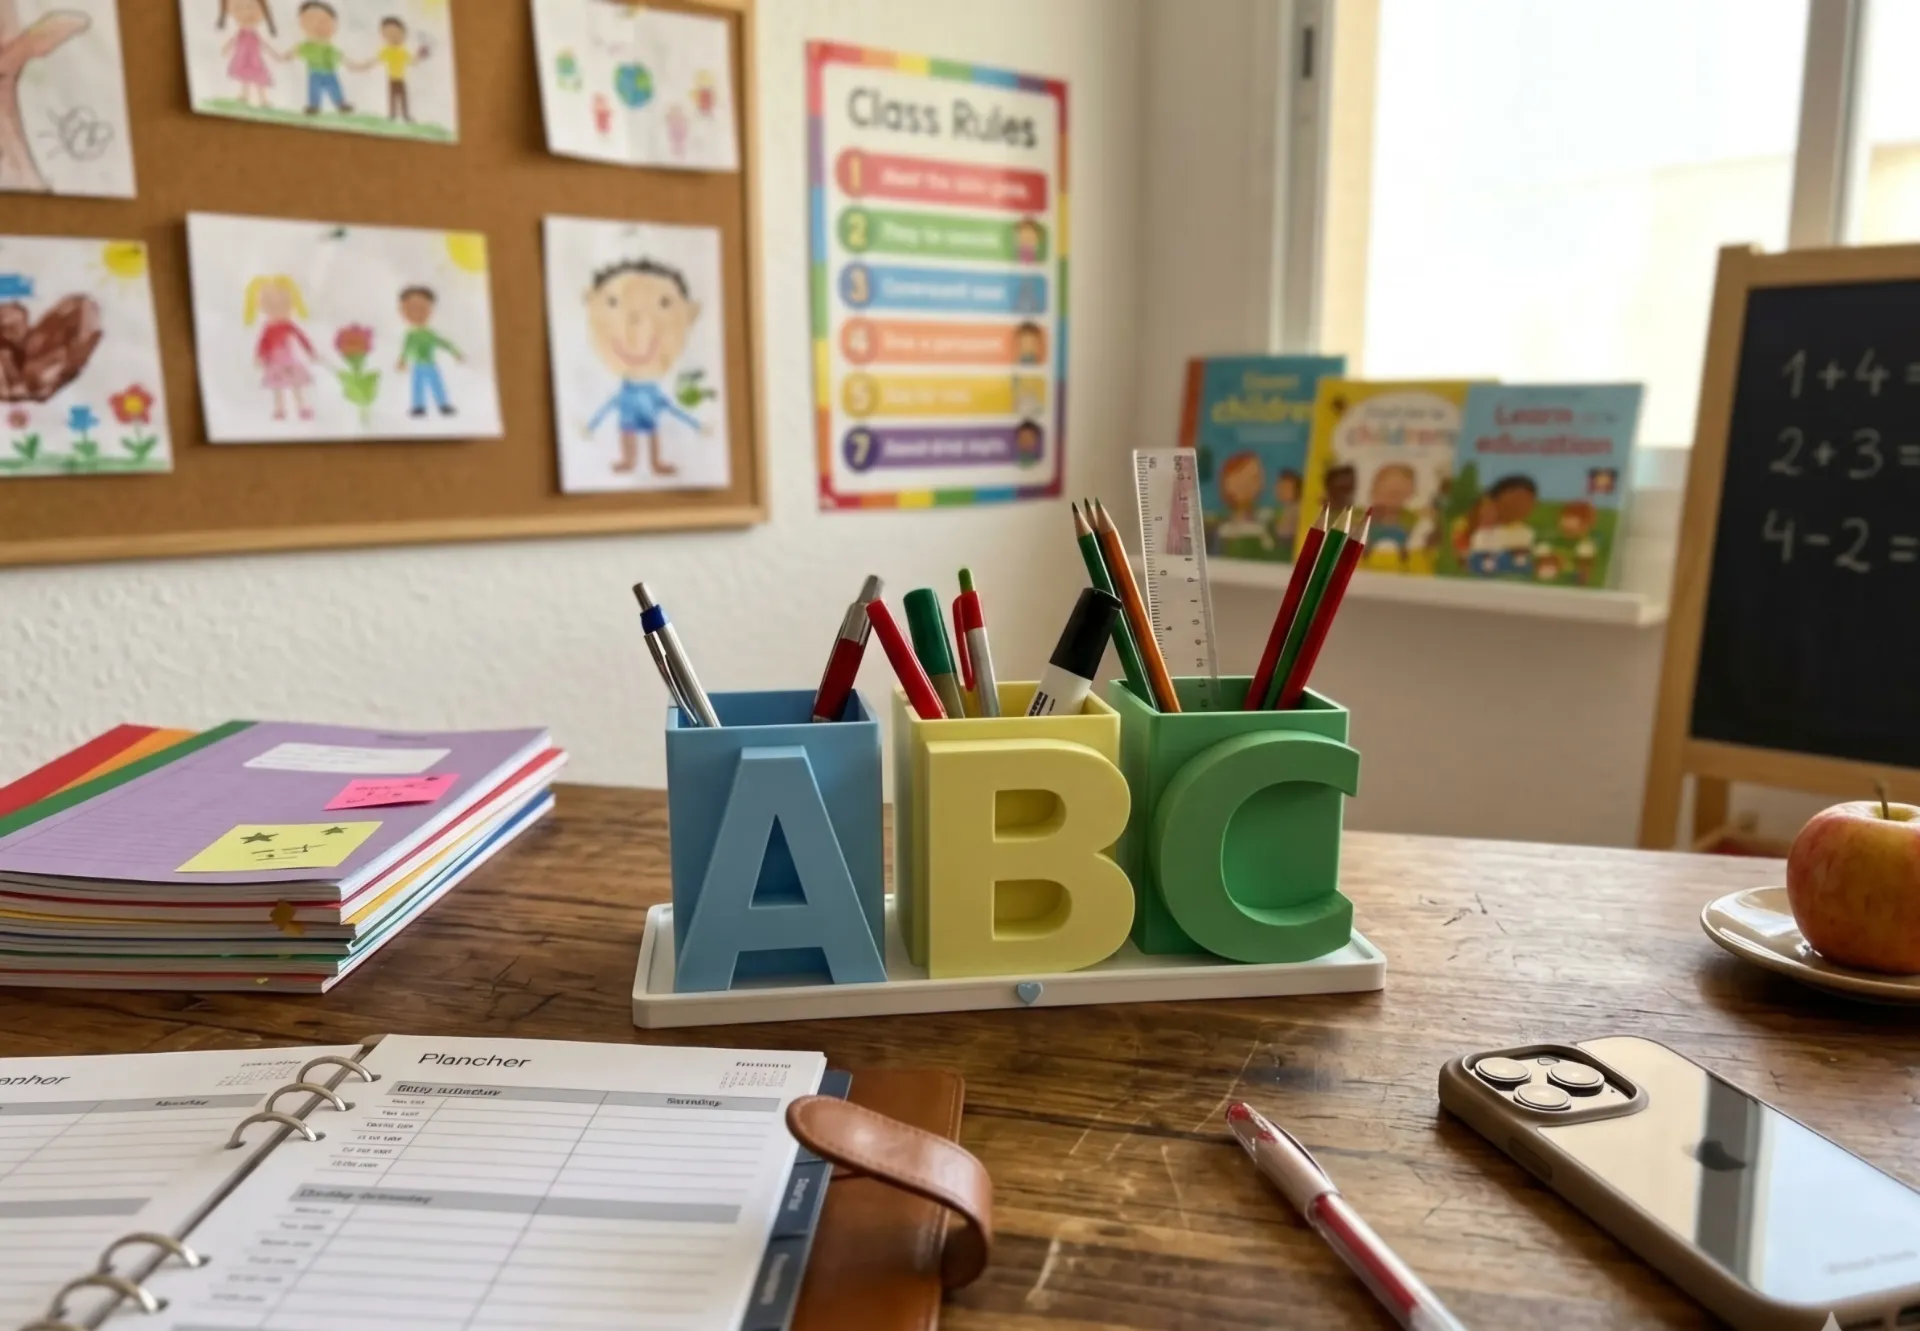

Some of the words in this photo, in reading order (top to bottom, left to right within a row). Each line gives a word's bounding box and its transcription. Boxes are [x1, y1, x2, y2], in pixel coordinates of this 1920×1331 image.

[848, 85, 940, 137] Class
[952, 98, 1037, 149] Rules
[849, 154, 861, 191] 1
[848, 211, 867, 248] 2
[850, 268, 869, 304] 3
[849, 326, 869, 357] 4
[851, 381, 870, 411] 5
[851, 431, 871, 466] 7
[674, 746, 887, 993] A
[927, 738, 1135, 979] B
[1156, 730, 1361, 963] C
[418, 1053, 531, 1068] Plancher
